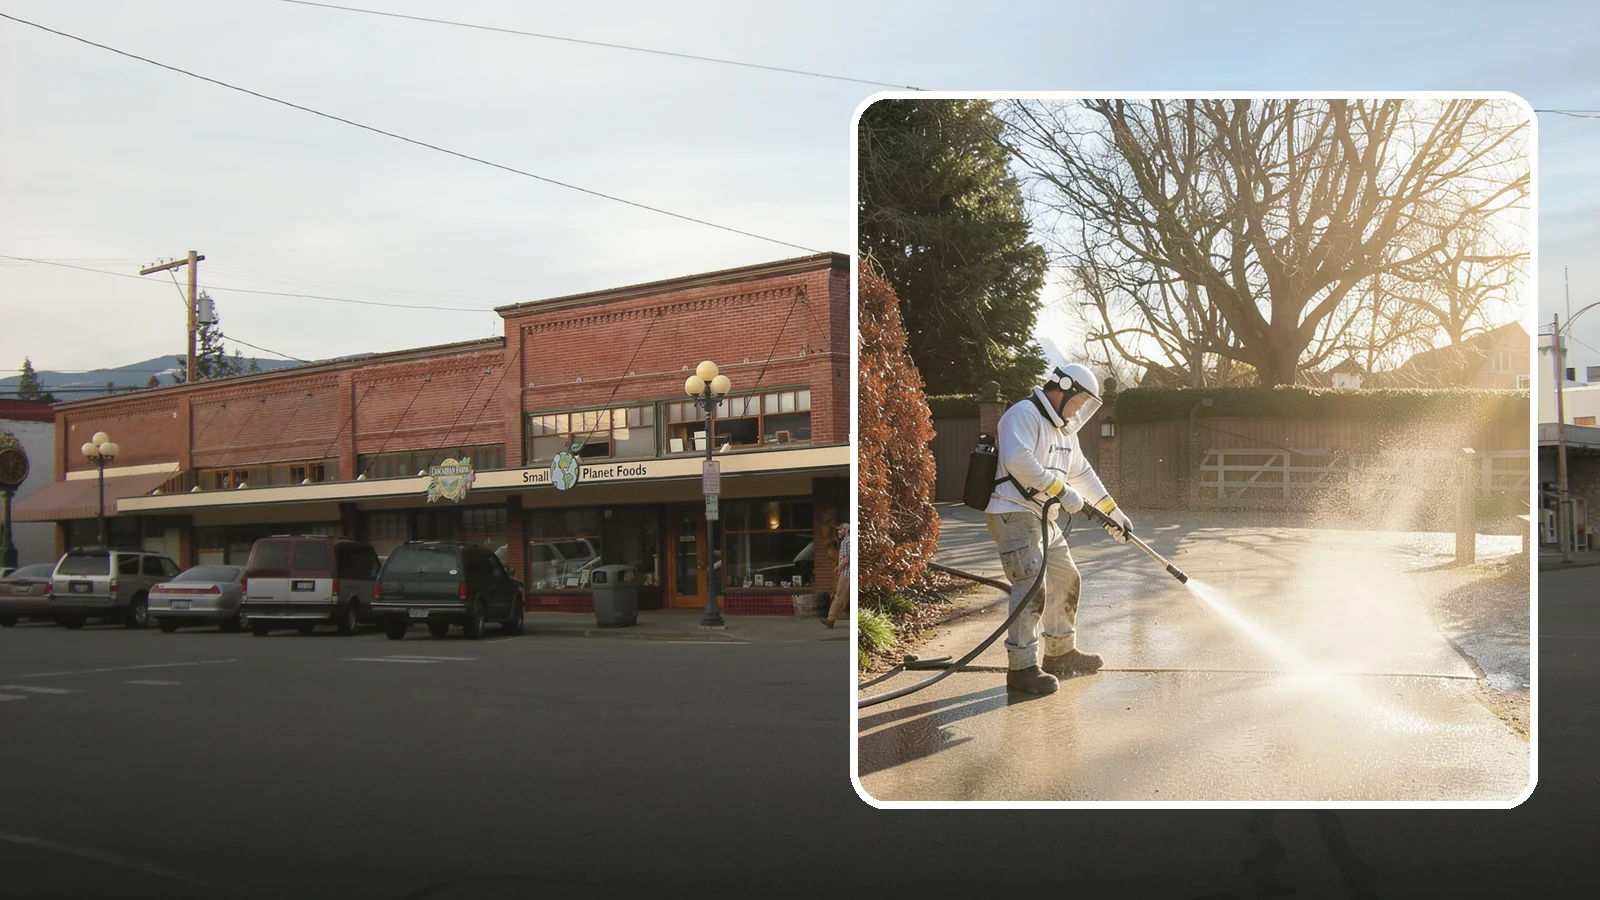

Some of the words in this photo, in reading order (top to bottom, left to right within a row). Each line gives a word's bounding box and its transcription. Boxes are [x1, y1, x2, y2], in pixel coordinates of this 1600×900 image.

[523, 470, 549, 483] Small
[582, 467, 614, 479] Planet
[616, 464, 647, 477] Foods
